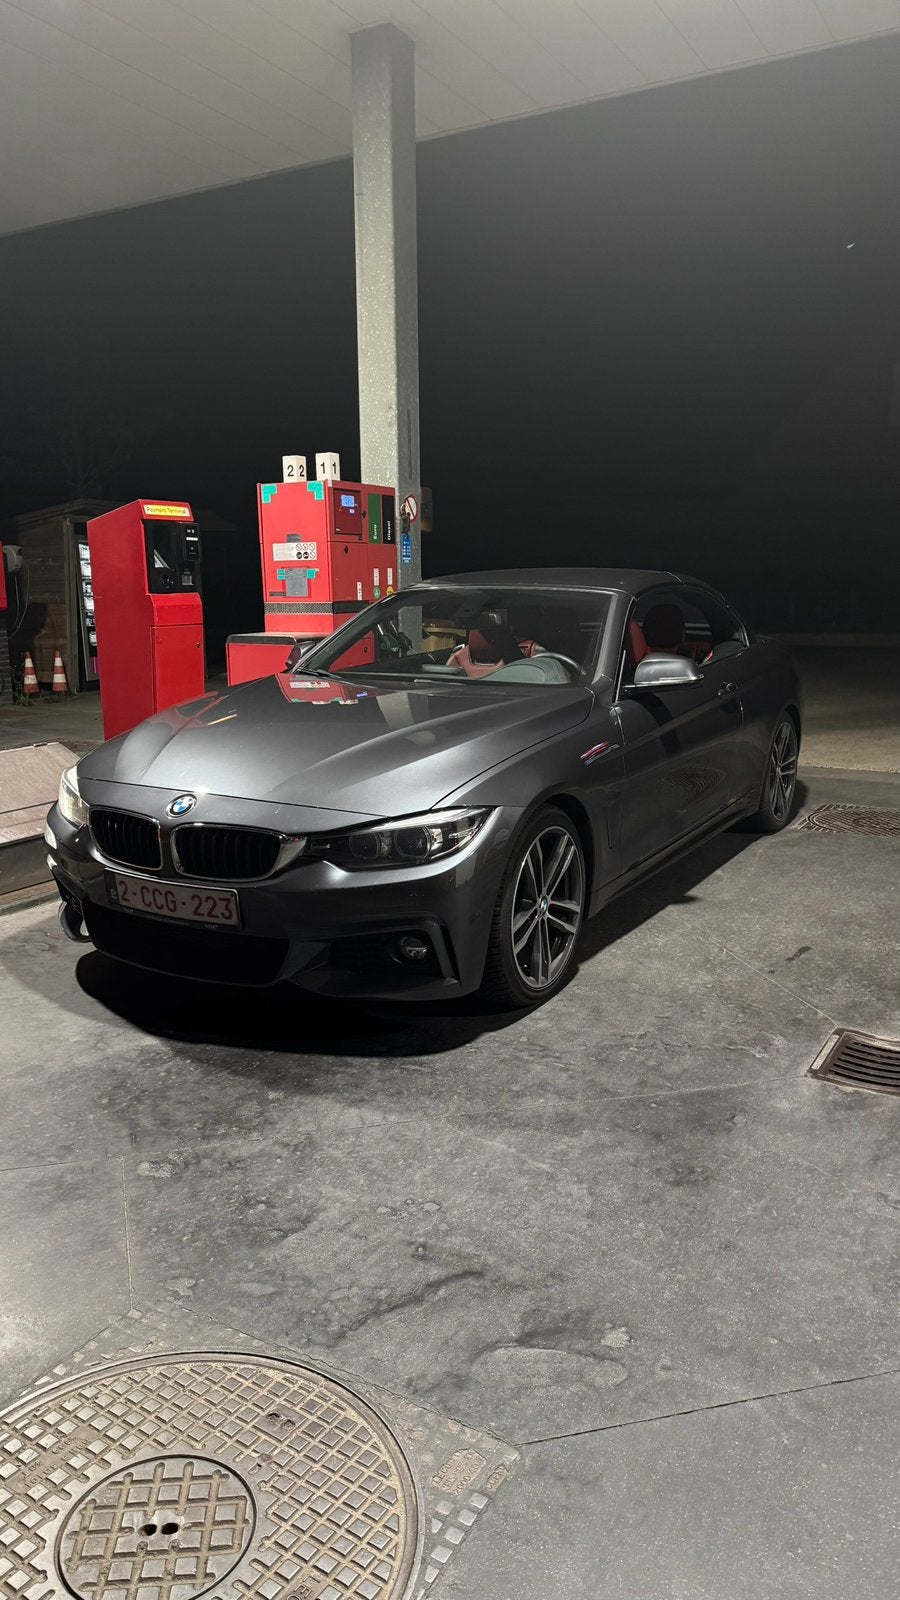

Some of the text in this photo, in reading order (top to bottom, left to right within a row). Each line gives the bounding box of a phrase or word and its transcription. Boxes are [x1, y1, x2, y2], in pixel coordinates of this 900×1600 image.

[287, 465, 294, 476] 2
[299, 465, 304, 476] 2
[320, 462, 326, 474] 1
[332, 462, 336, 474] 1
[119, 880, 233, 920] 2-CCG-223
